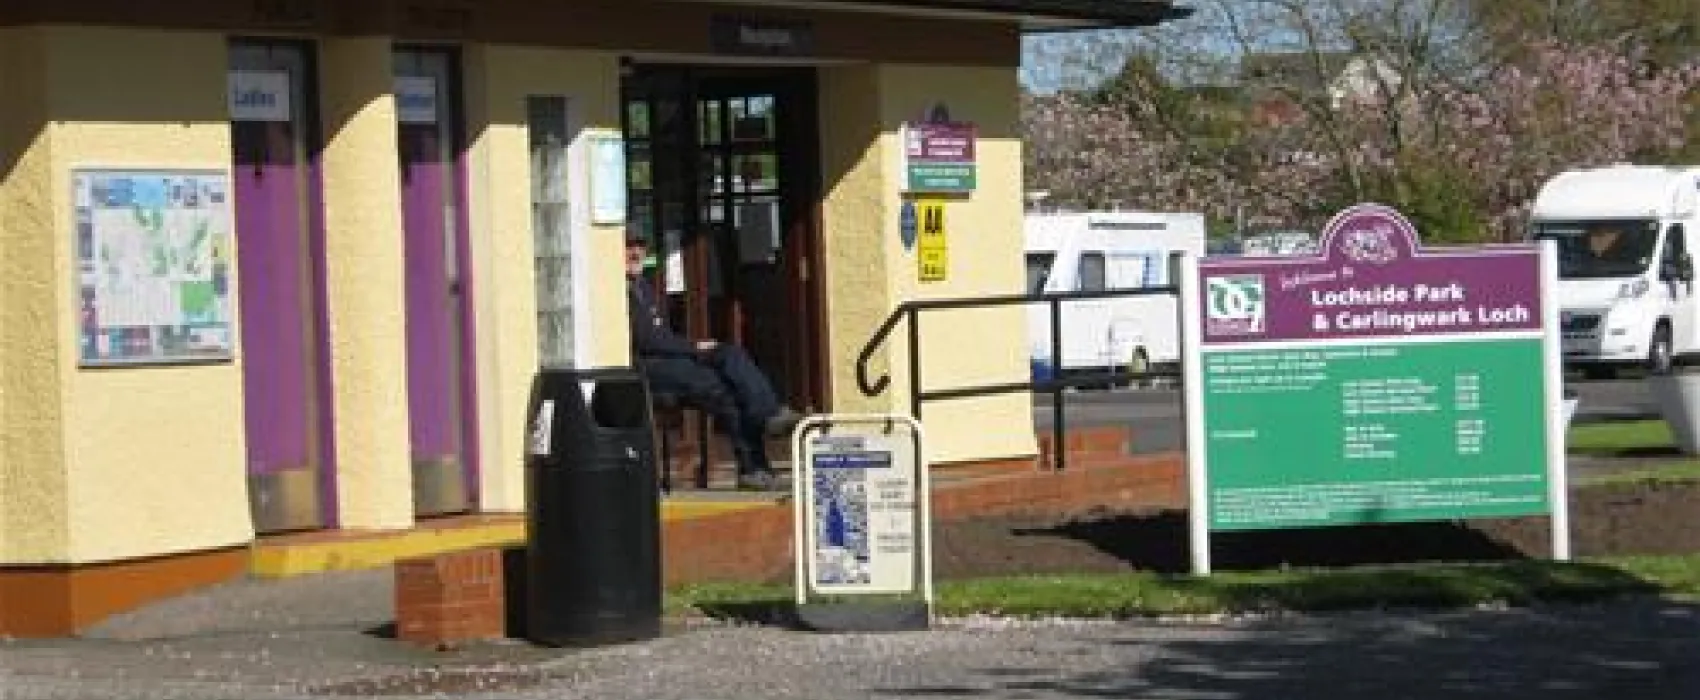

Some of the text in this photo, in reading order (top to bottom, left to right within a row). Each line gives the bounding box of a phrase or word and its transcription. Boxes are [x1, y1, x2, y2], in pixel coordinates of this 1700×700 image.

[233, 88, 277, 108] Ladies
[1311, 283, 1463, 306] Lochside Park
[1312, 304, 1532, 333] & Carlingwark Loch
